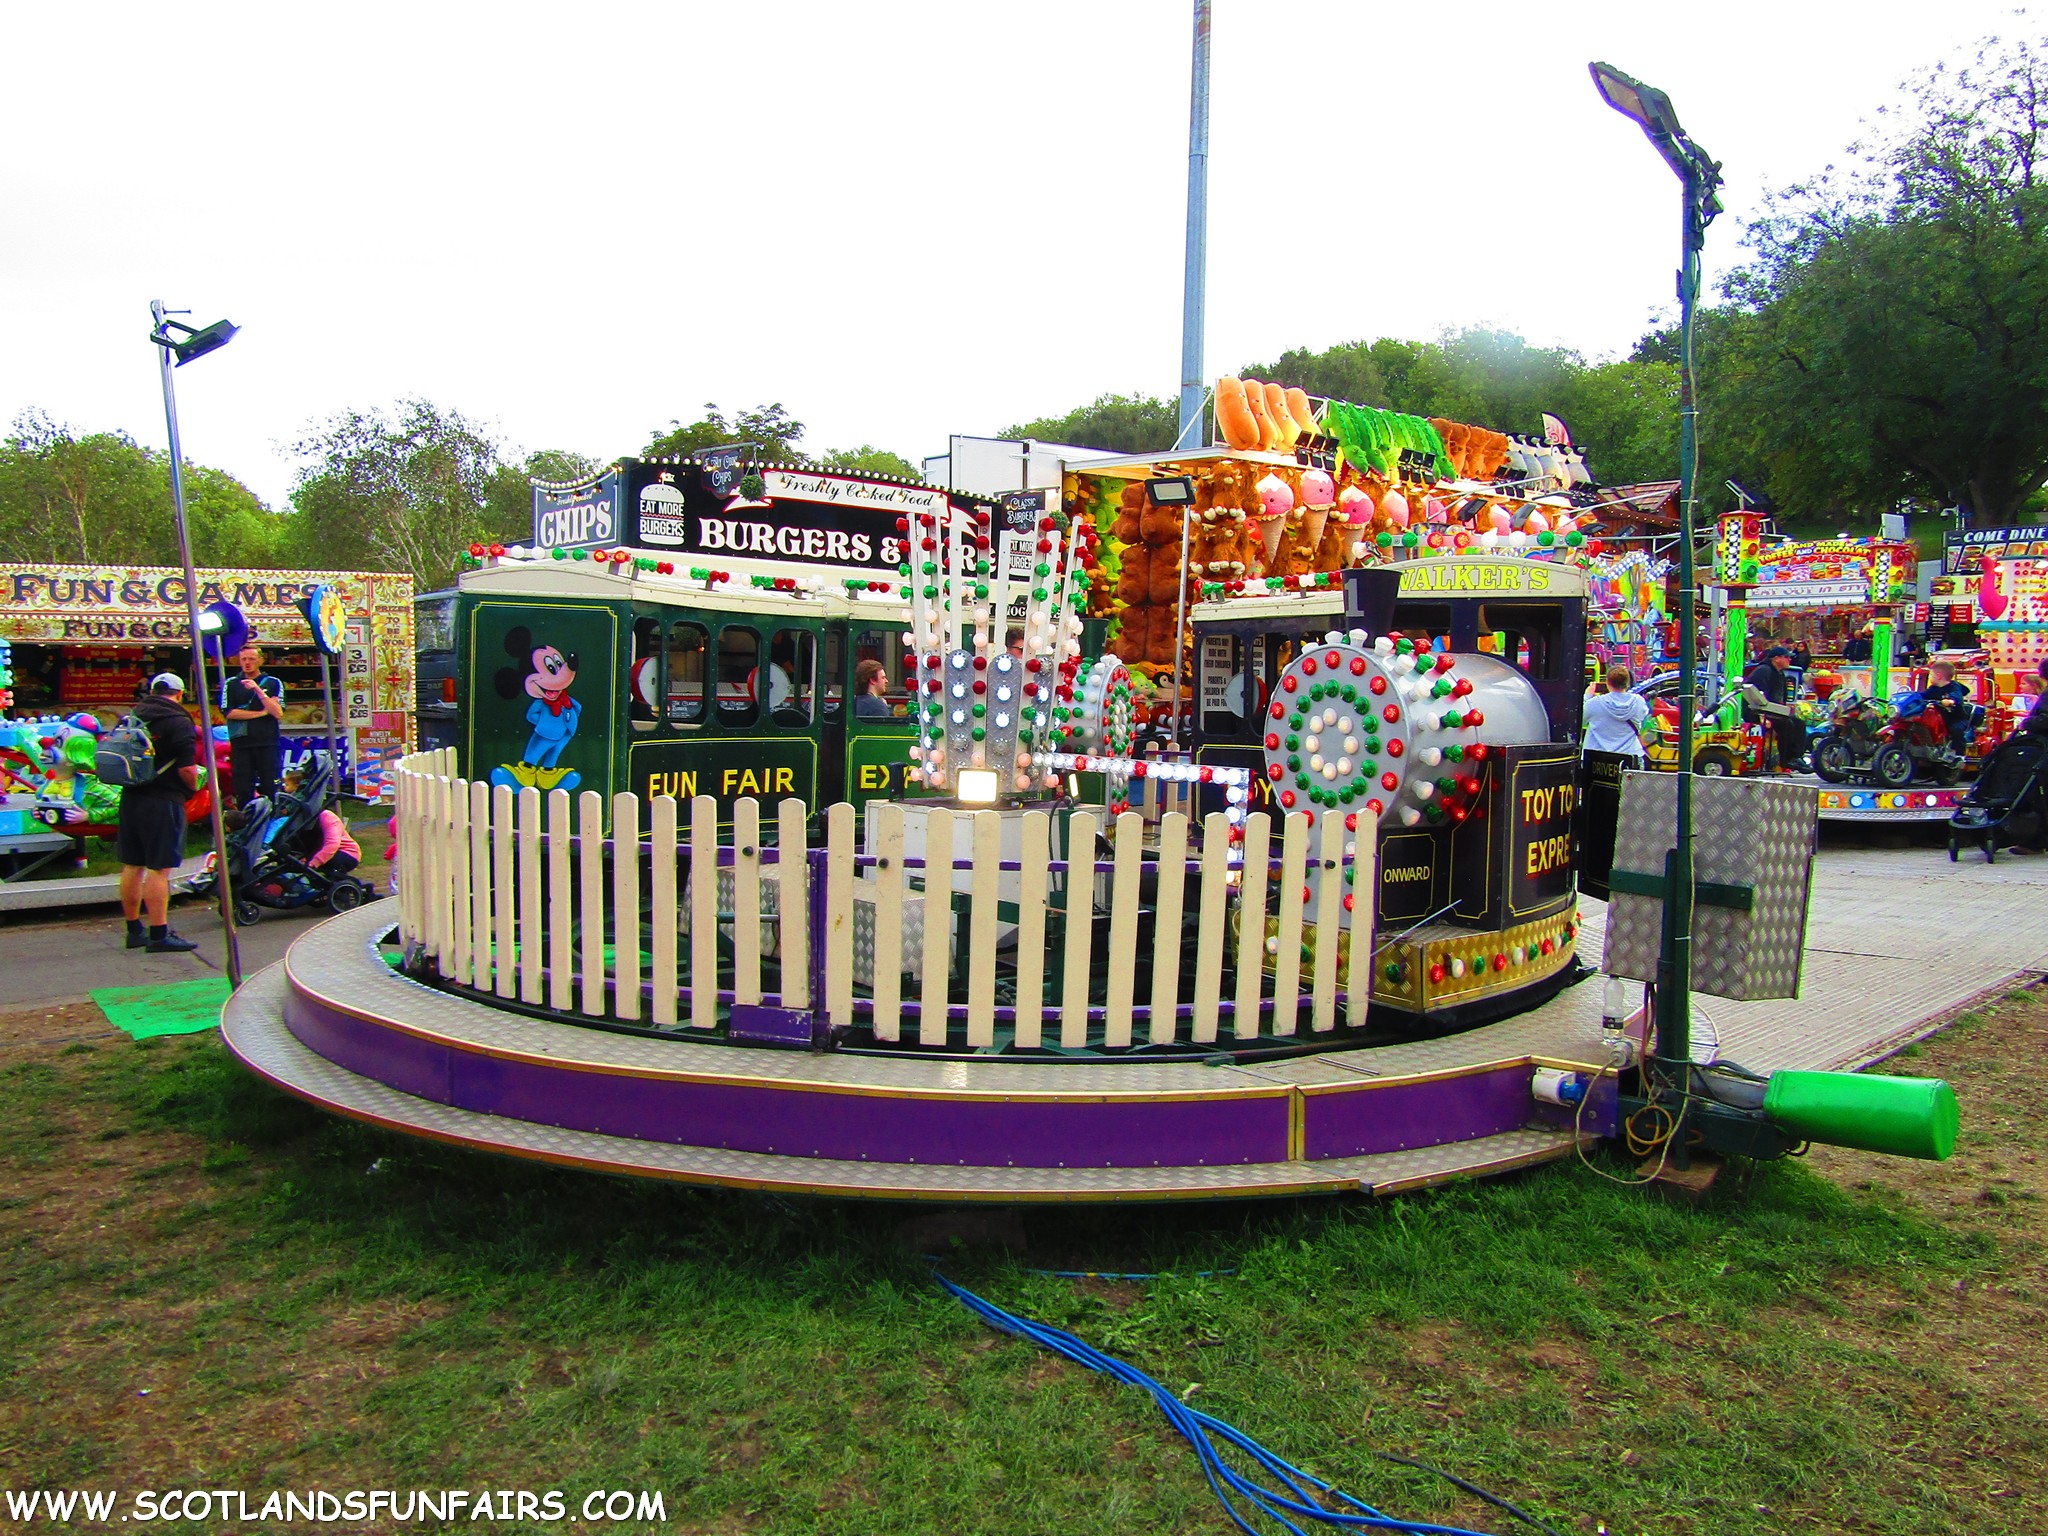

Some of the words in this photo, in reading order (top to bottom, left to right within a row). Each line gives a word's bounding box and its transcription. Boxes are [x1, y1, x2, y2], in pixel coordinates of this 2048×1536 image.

[712, 470, 732, 487] CHIPS
[782, 474, 841, 500] Freshly
[846, 483, 895, 502] Cooked
[899, 489, 934, 506] Food
[640, 500, 656, 513] EAT
[659, 502, 684, 516] MORE
[540, 500, 612, 548] CHIPS
[640, 518, 684, 537] BURGERS
[699, 517, 870, 562] BURGERS
[880, 536, 902, 564] &
[1963, 530, 2006, 543] COME
[2009, 528, 2047, 540] DINE
[1758, 549, 1794, 564] TOFFEE
[1813, 546, 1871, 556] CHOCOLAT
[1785, 541, 1813, 551] HAND
[1790, 554, 1841, 565] APPLES
[1399, 564, 1549, 592] WALKER'S
[1344, 578, 1365, 617] 1
[1838, 584, 1867, 592] STYL
[350, 650, 363, 659] 3
[353, 695, 364, 704] 6
[650, 770, 697, 799] FUN
[723, 767, 795, 796] FAIR
[1522, 786, 1554, 823] TOY
[1558, 784, 1574, 816] TO
[1528, 833, 1570, 875] EXPRE
[1384, 865, 1431, 884] ONWARD
